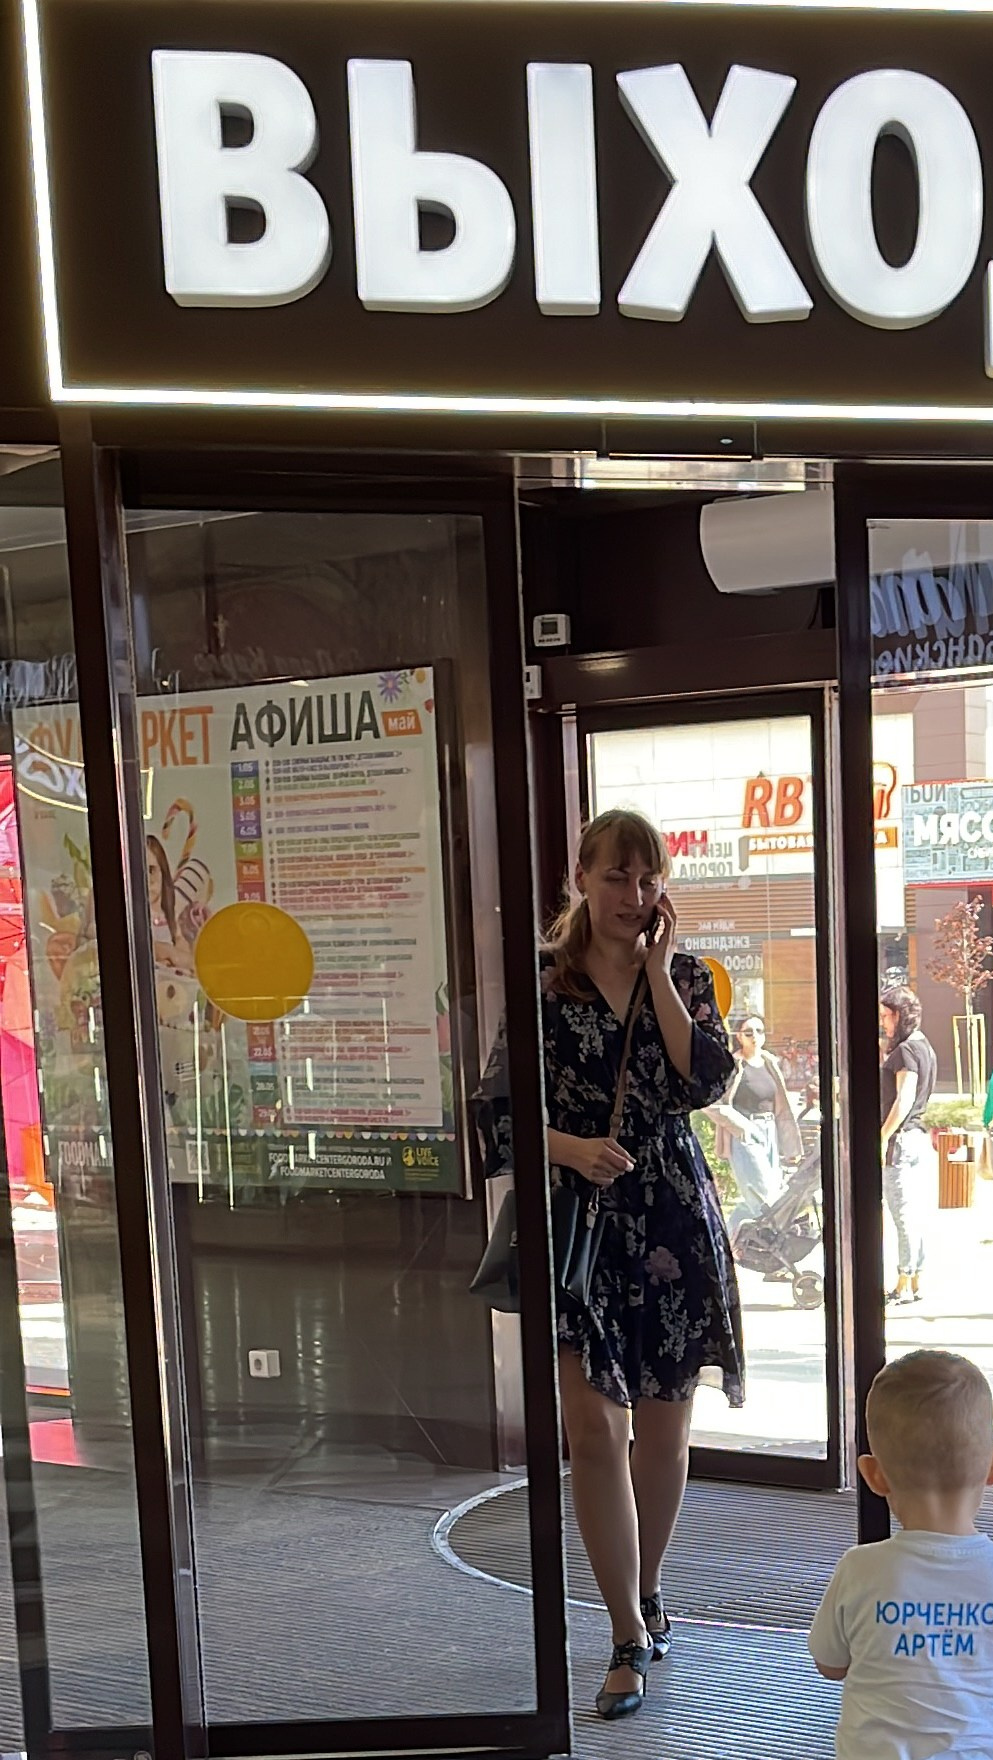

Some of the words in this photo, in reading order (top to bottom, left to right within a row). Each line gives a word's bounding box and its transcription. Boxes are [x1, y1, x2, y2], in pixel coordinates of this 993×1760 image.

[230, 690, 382, 752] АФИША
[388, 712, 416, 731] май
[742, 776, 813, 829] RB
[894, 1629, 974, 1657] АРТЁМ
